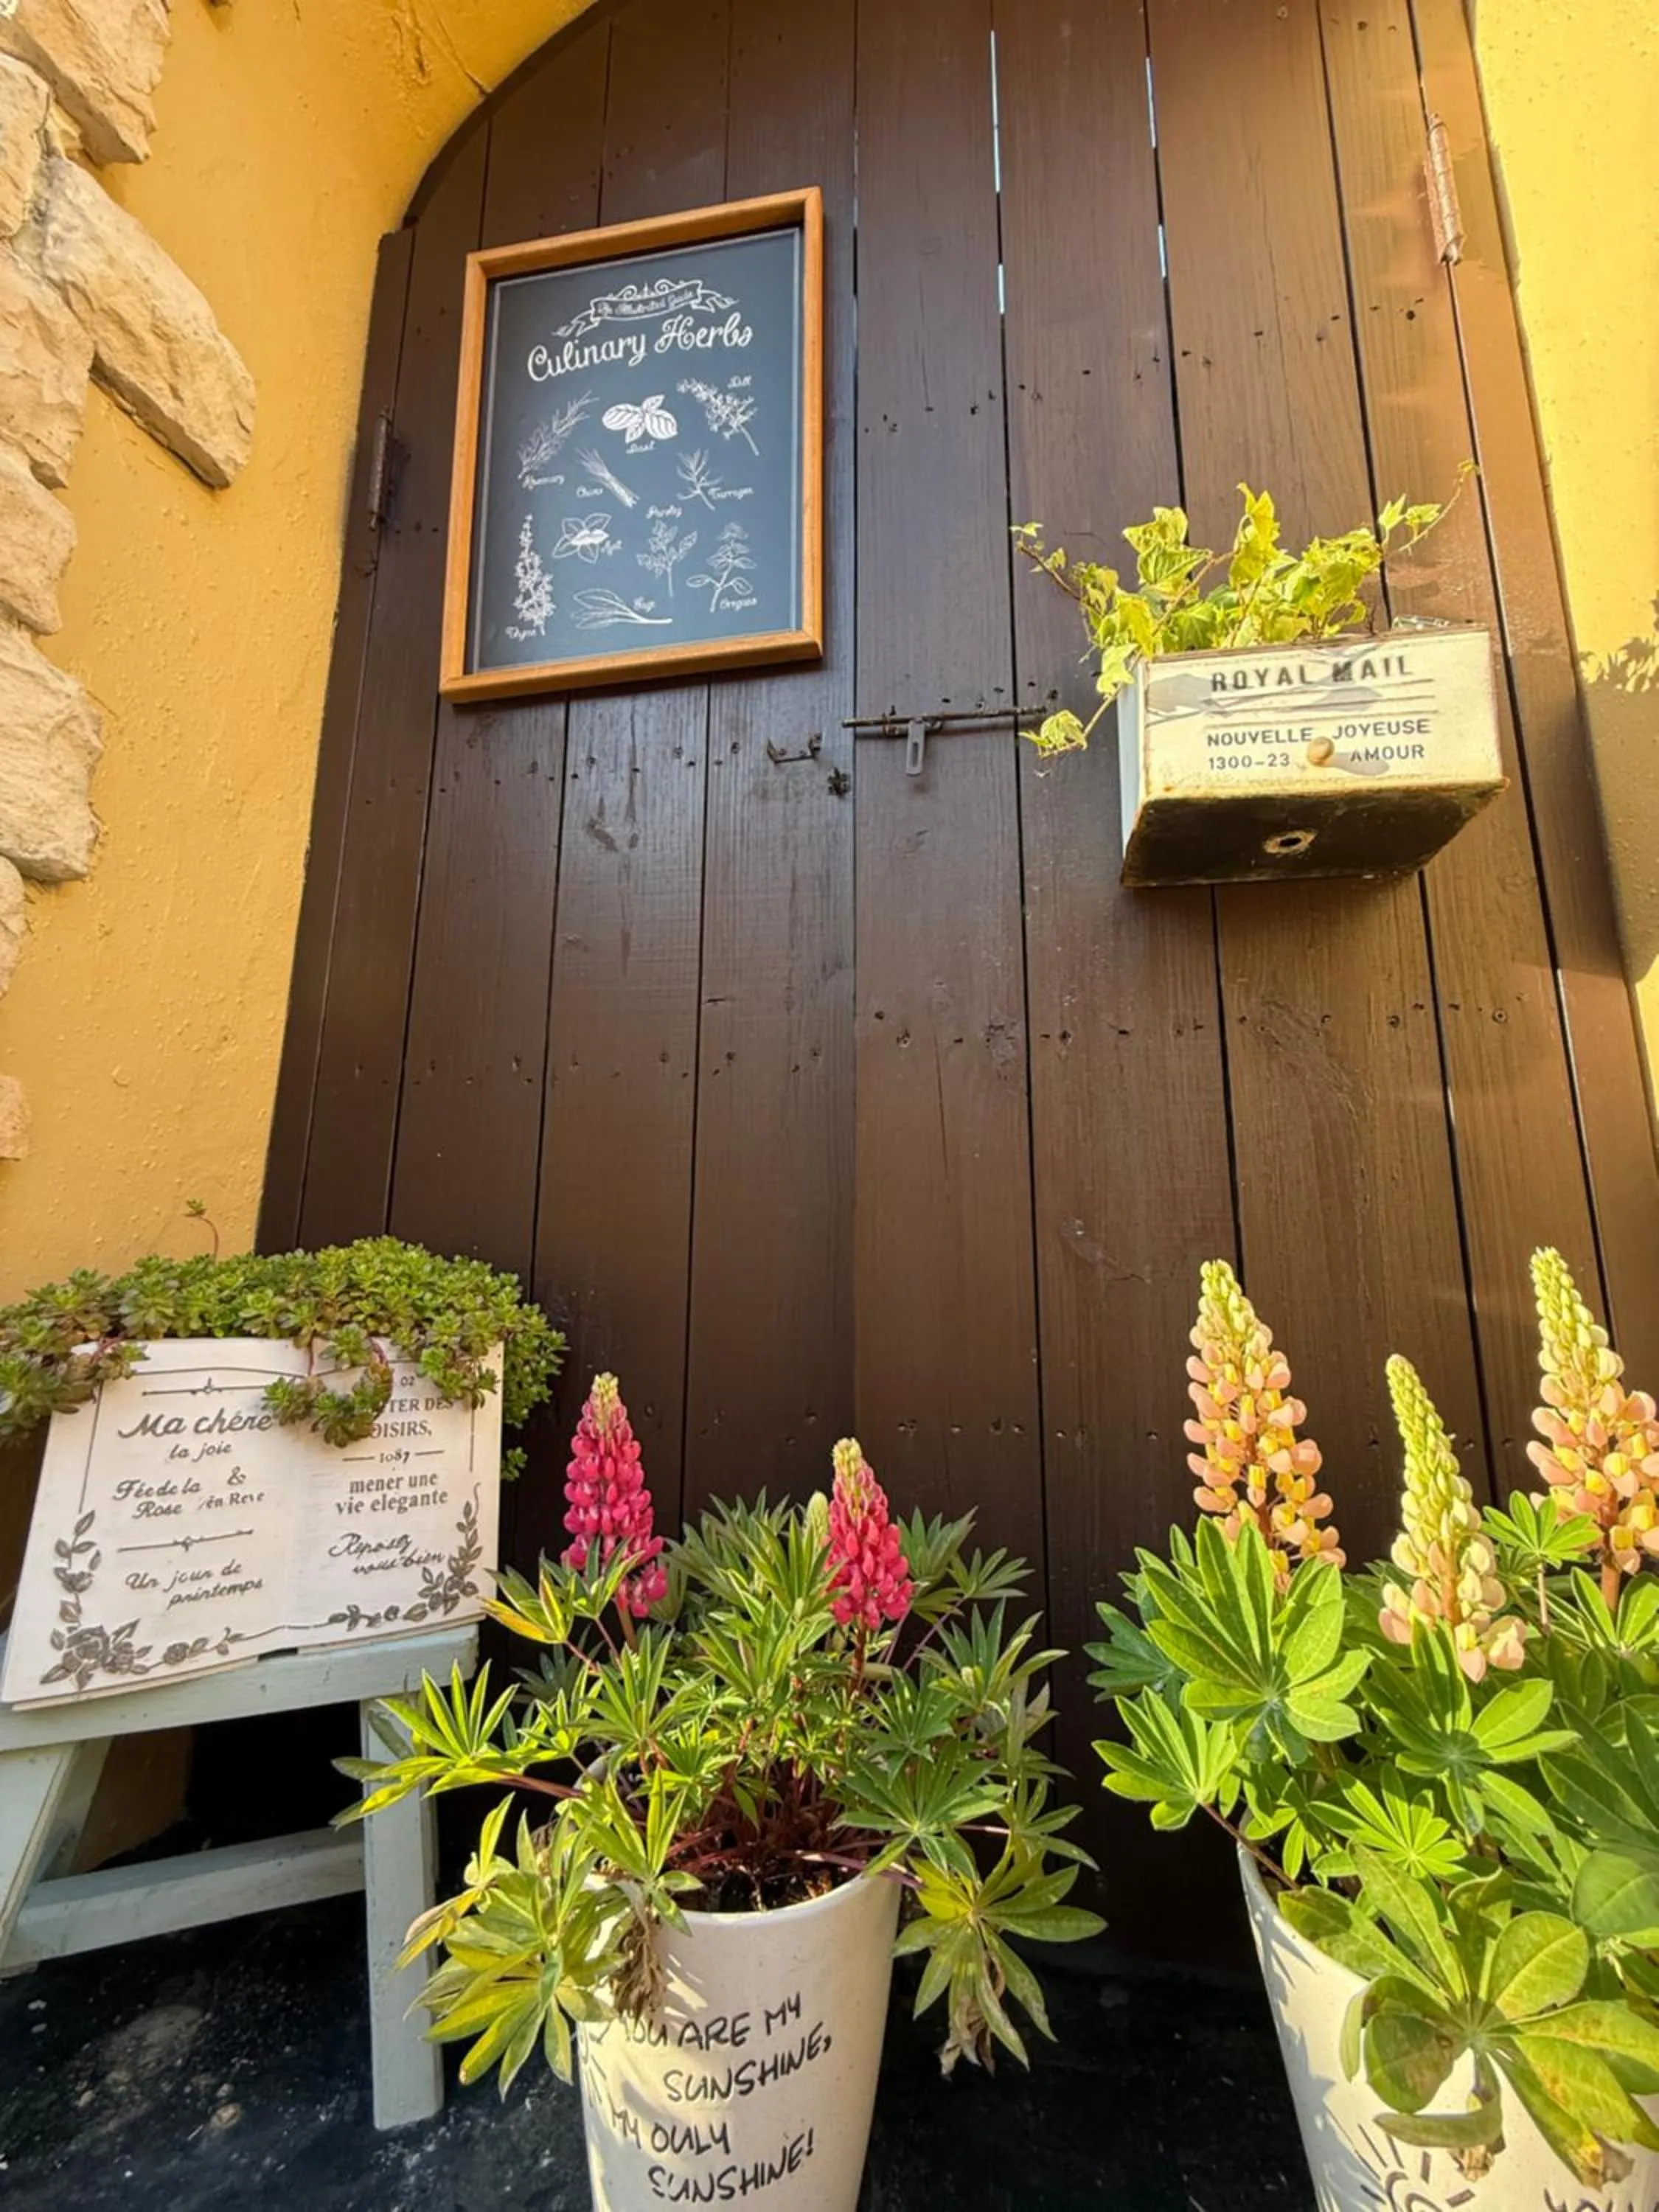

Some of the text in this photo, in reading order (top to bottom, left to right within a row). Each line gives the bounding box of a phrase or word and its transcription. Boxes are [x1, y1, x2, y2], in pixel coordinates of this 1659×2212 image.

[527, 311, 754, 381] Culinary Herbs
[1211, 655, 1413, 692] ROYAL MAIL
[1207, 718, 1431, 747] NOUVELLE JOYEUSE
[1208, 744, 1425, 771] 1300-23 AMOUR
[118, 1413, 187, 1438] Ma
[370, 1419, 433, 1439] OISIRS,
[168, 1441, 232, 1462] la joie
[227, 1466, 246, 1485] &
[349, 1472, 439, 1494] mener une
[131, 1500, 183, 1520] Rose
[335, 1489, 449, 1515] vie elegante
[125, 1558, 242, 1593] Un jour de
[166, 1579, 264, 1611] printemps
[678, 2011, 751, 2052] ARE
[764, 1992, 801, 2037] MY
[663, 2021, 832, 2102] SUNSHINE,
[611, 2109, 641, 2149] MY
[647, 2126, 815, 2203] SUNSHINE!
